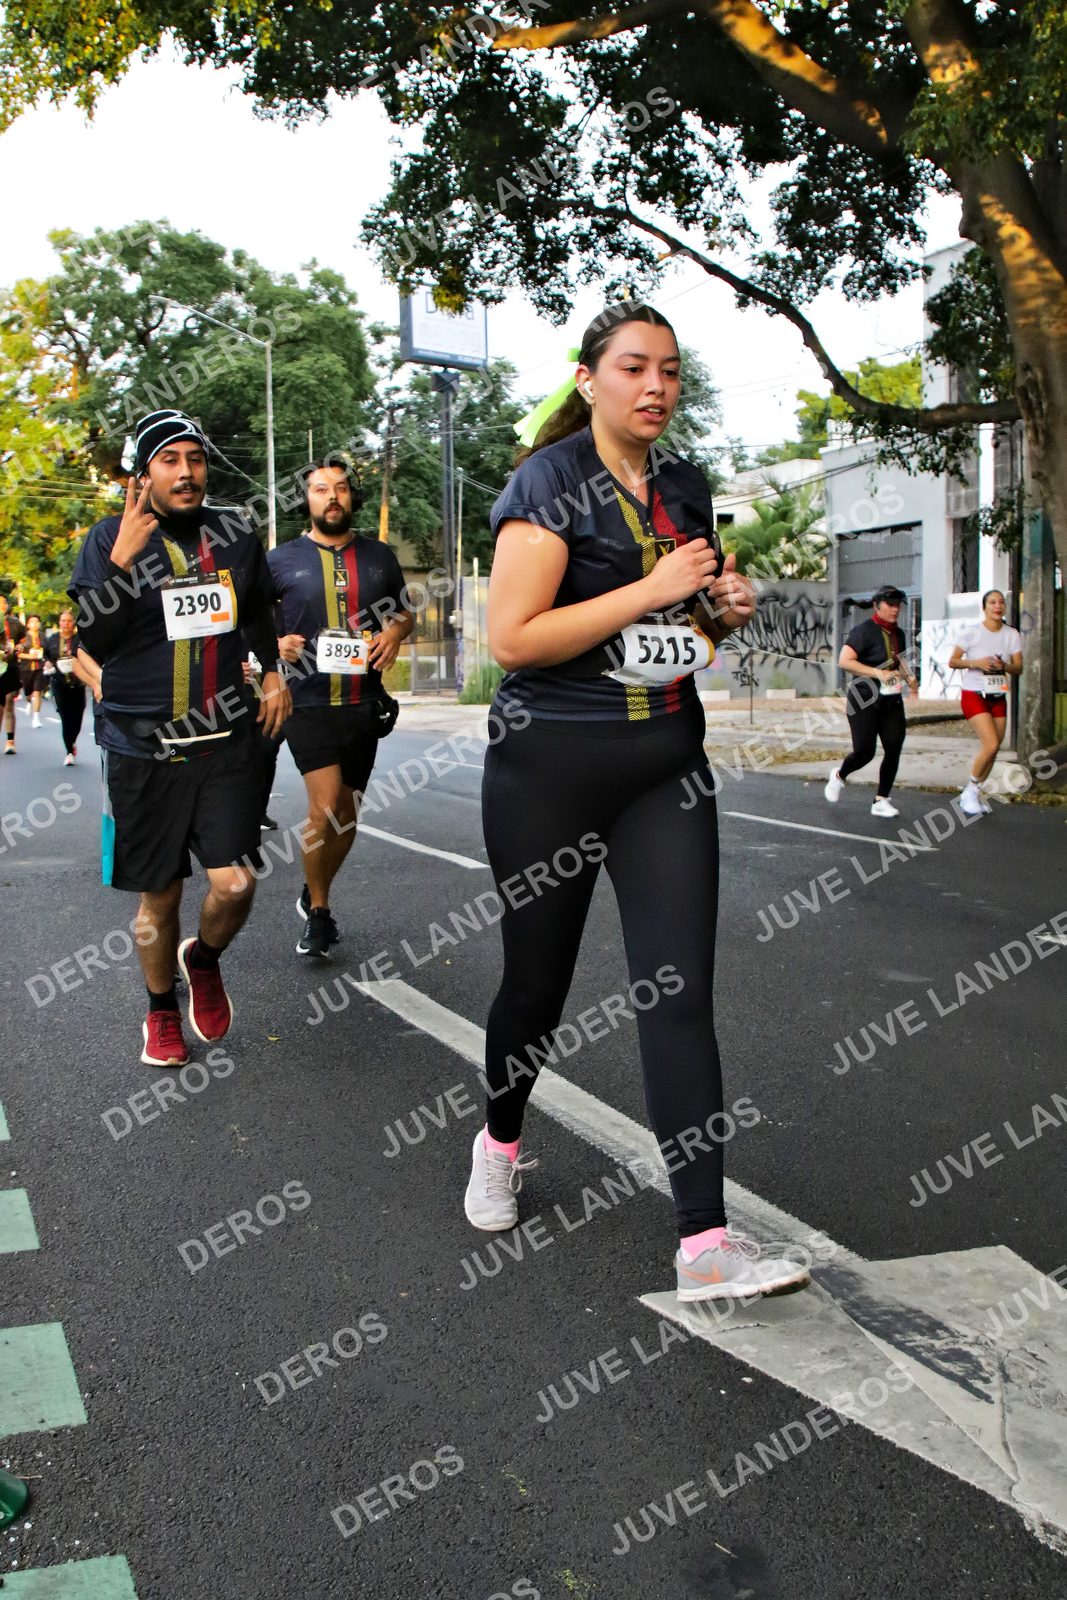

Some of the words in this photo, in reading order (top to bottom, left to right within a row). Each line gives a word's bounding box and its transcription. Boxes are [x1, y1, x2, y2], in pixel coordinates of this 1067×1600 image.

[173, 592, 221, 616] 2390
[325, 643, 360, 658] 3895
[637, 634, 696, 665] 5215
